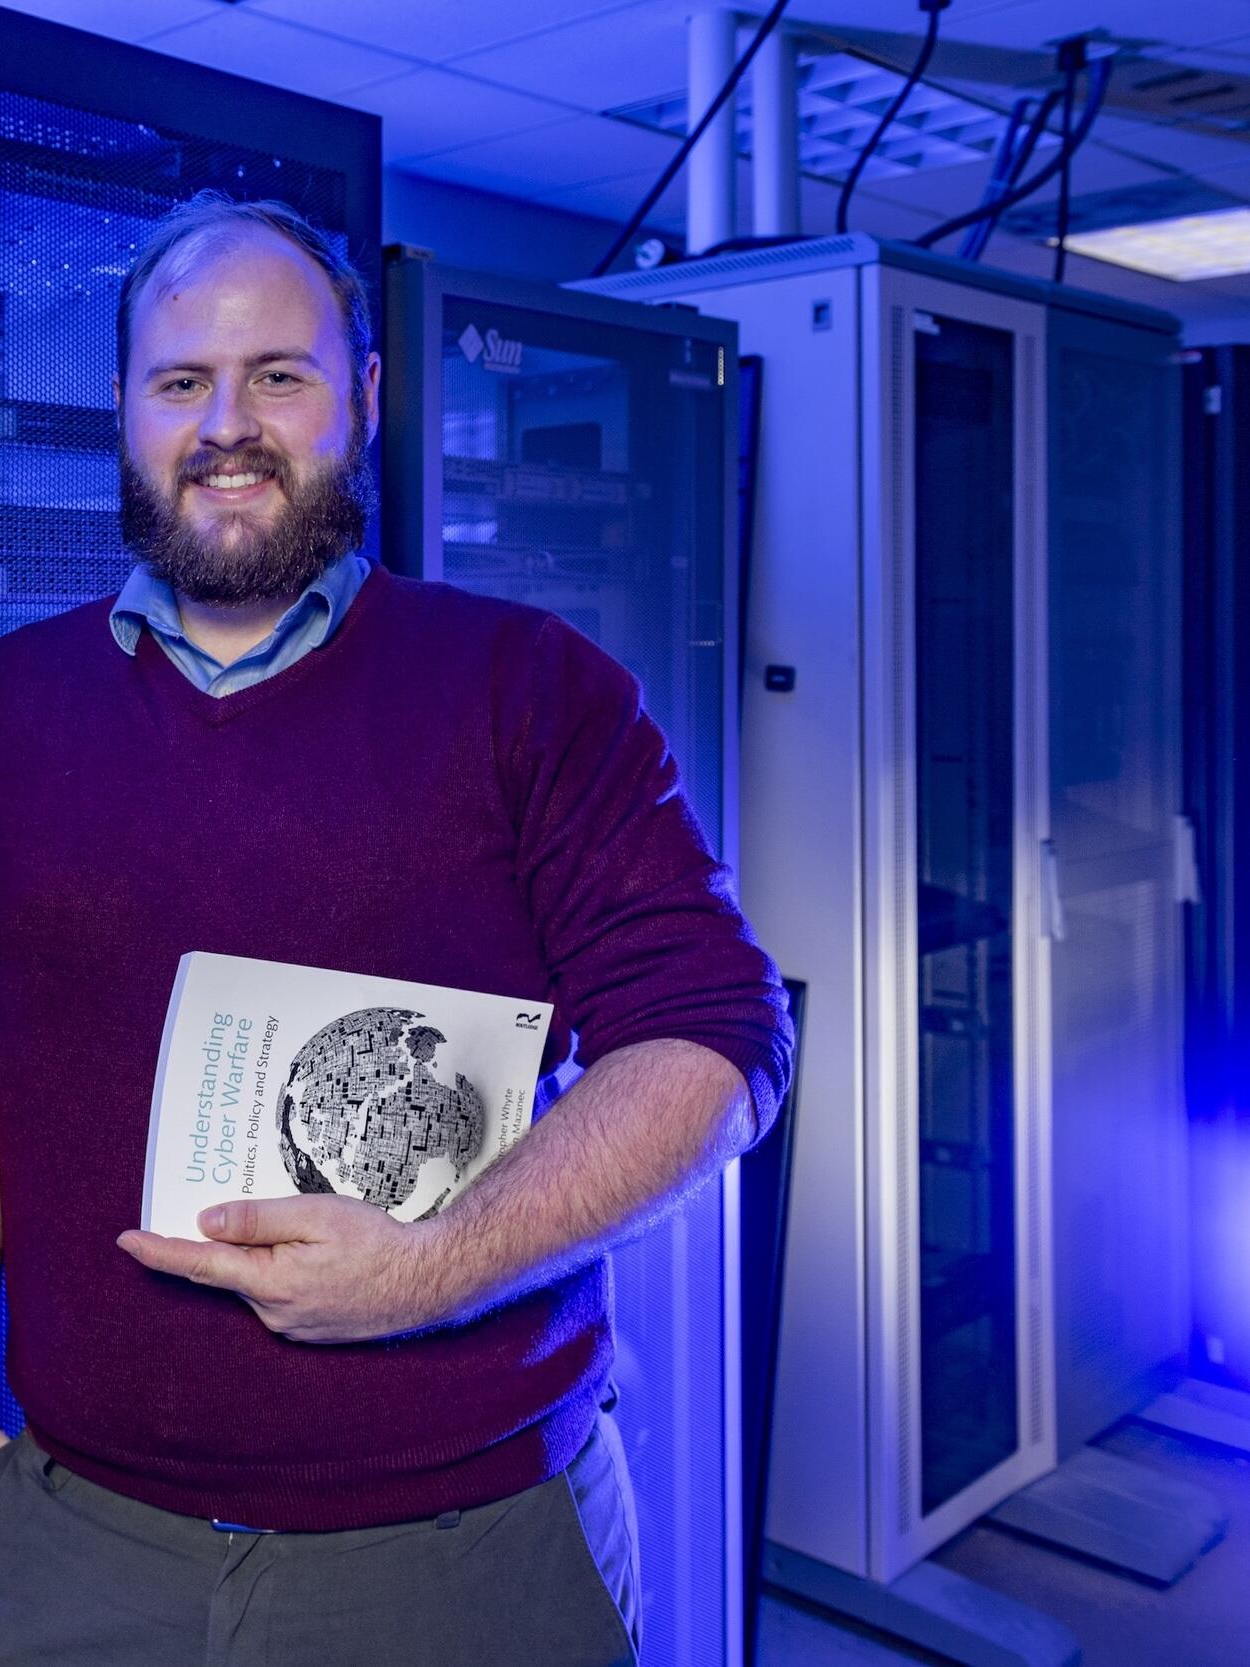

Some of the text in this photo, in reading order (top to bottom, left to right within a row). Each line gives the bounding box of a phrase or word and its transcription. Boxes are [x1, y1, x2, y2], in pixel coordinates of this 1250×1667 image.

[186, 1012, 233, 1183] Understanding
[212, 1018, 253, 1184] Cyber Warfare
[242, 1015, 279, 1194] Politics, Policy and Strategy
[501, 1088, 514, 1121] Whyte
[512, 1090, 526, 1135] Mazanec
